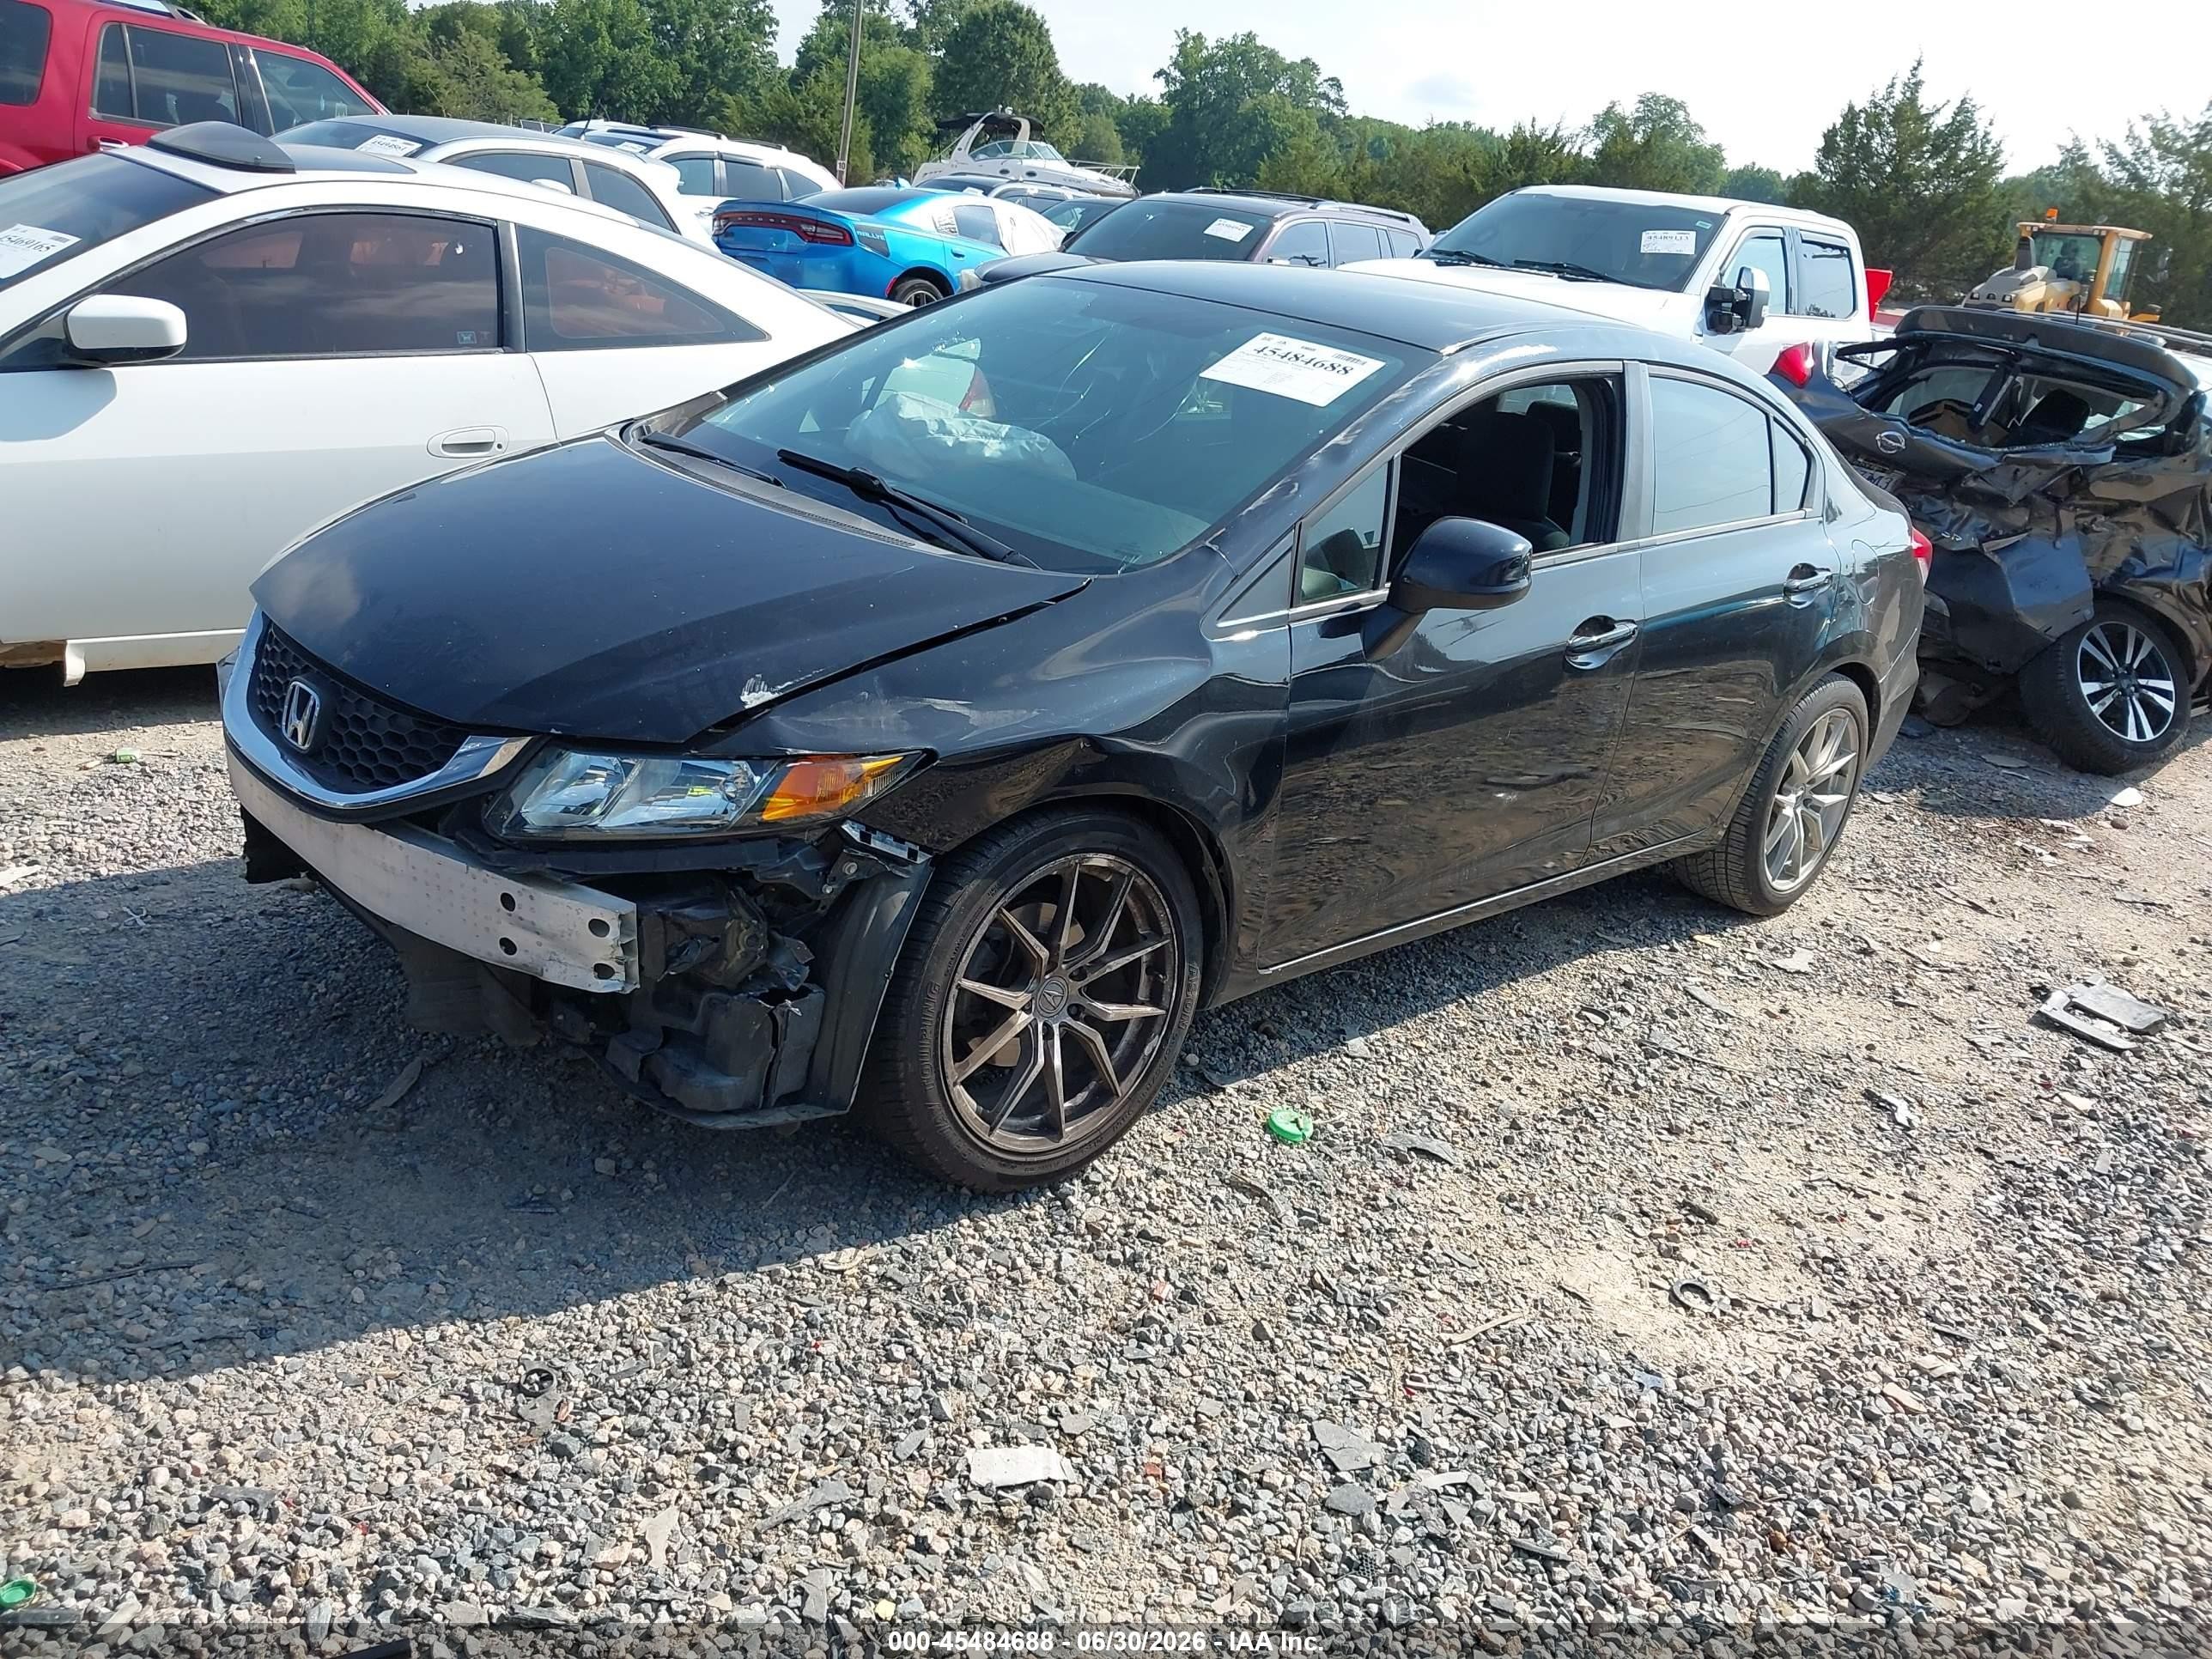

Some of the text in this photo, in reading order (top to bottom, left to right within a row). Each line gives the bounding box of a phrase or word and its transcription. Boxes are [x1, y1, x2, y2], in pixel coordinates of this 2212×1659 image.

[838, 161, 846, 170] 10
[856, 231, 886, 241] RALLYE
[1254, 345, 1354, 376] 45484688
